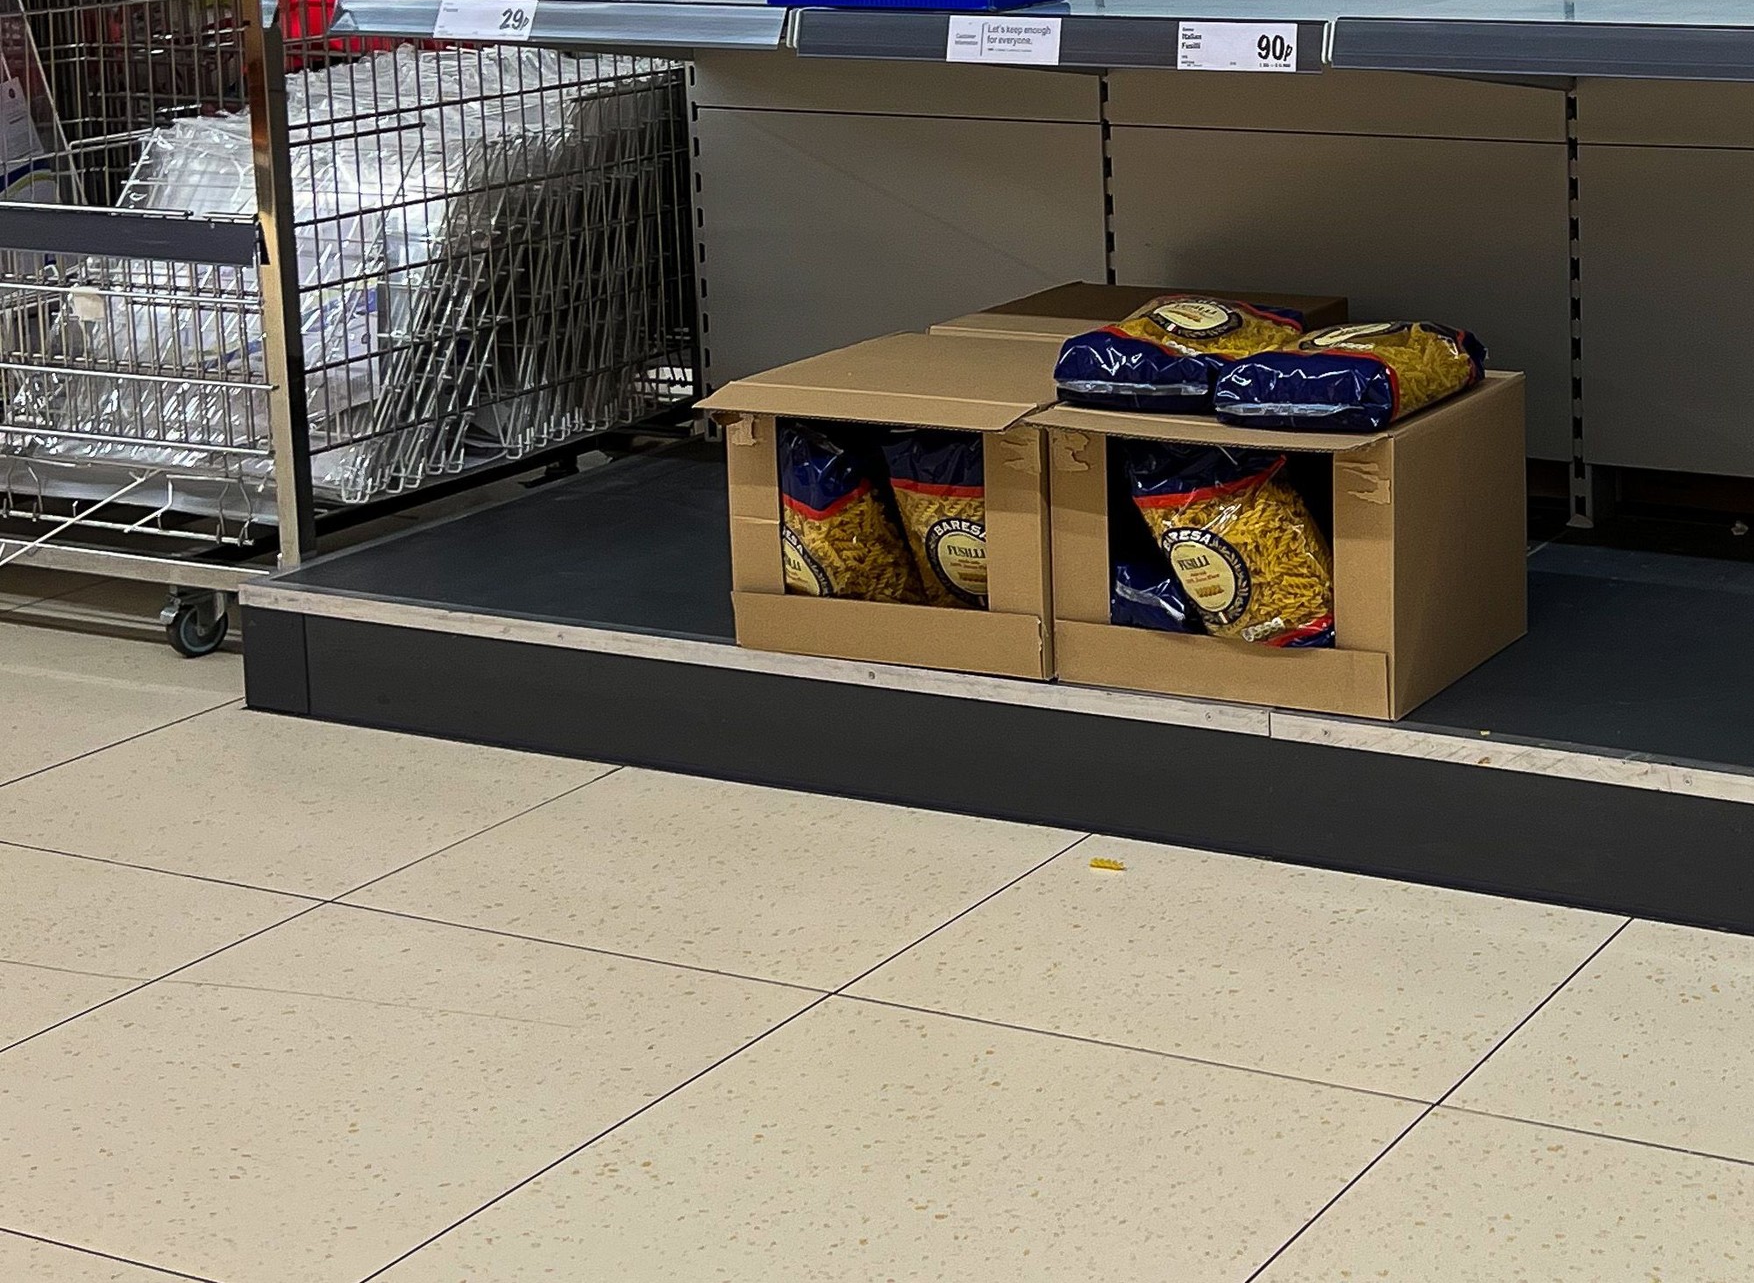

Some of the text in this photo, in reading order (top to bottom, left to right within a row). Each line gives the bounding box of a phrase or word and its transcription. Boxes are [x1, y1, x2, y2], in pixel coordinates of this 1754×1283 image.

[499, 8, 530, 30] 29p
[987, 25, 1051, 36] Let's keep enough
[987, 35, 997, 44] for
[1257, 34, 1293, 61] 90p
[1163, 530, 1211, 551] BARESA
[1177, 555, 1210, 570] FUSILLI
